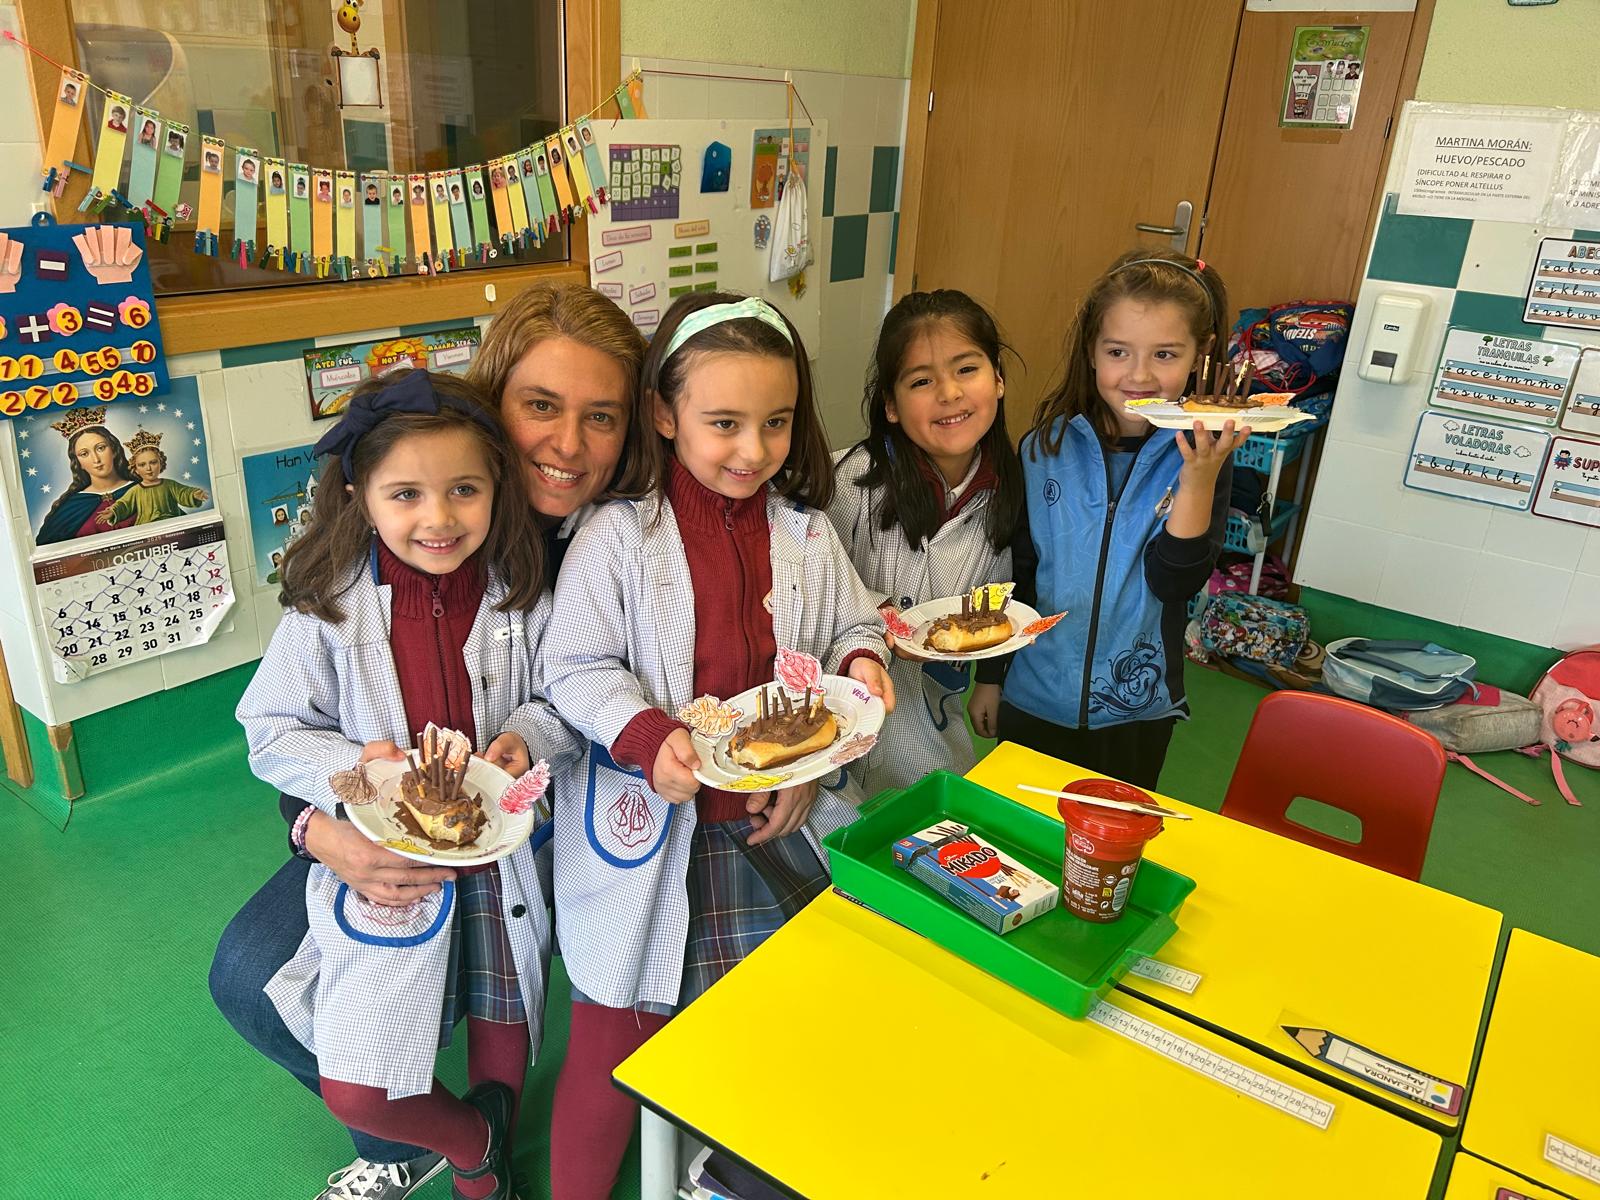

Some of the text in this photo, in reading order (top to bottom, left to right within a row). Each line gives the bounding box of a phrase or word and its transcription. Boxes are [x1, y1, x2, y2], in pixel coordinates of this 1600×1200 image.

[1436, 137, 1533, 150] MARTINA MORÁN:
[1435, 154, 1525, 167] HUEVO/PESCADO
[1415, 179, 1503, 191] SÍNCOPE PONER ALTELLUS
[1417, 169, 1459, 178] (DIFICULTAD
[1471, 172, 1503, 180] RESPIRAR
[1562, 283, 1569, 295] k
[1582, 290, 1597, 298] m
[62, 307, 146, 331] 3 6
[1477, 346, 1540, 365] TRANQUILAS
[1493, 337, 1532, 352] LETRAS
[1, 343, 154, 378] 1 1 4 5 5 10
[1457, 367, 1467, 375] a
[1470, 369, 1479, 377] c
[1495, 371, 1502, 380] i
[1505, 375, 1521, 384] m
[1523, 377, 1536, 386] n
[5, 373, 149, 413] 2 7 2 9 4 8
[1473, 391, 1483, 400] u
[1524, 400, 1536, 408] x
[1545, 403, 1555, 411] z
[1460, 424, 1504, 440] LETRAS
[1445, 433, 1512, 455] VOLADORAS
[276, 453, 302, 470] Han
[1445, 460, 1456, 472] d
[1463, 463, 1474, 476] h
[1481, 466, 1489, 479] k
[1512, 472, 1521, 485] t
[1573, 456, 1600, 472] SUP
[112, 542, 179, 567] OCTUBRE
[109, 551, 216, 585] 1 2 3 4 5
[58, 568, 220, 618] 6 7 8 9 10 11 12
[59, 584, 223, 638] 13 14 15 16 17 18 19
[62, 608, 203, 657] 20 21 22 23 24 25
[91, 632, 181, 666] 28 29 30 31
[941, 846, 998, 876] MIKADO
[1098, 1009, 1106, 1017] 11
[1119, 1019, 1128, 1027] 13
[1130, 1024, 1138, 1032] 14
[1140, 1029, 1149, 1037] 15
[1151, 1034, 1160, 1042] 16
[1162, 1039, 1172, 1047] 17
[1173, 1044, 1182, 1052] 18
[1184, 1050, 1193, 1058] 19
[1195, 1055, 1205, 1063] 20
[1206, 1060, 1216, 1068] 21
[1218, 1065, 1228, 1074] 22
[1229, 1071, 1240, 1079] 23
[1241, 1076, 1251, 1084] 24
[1253, 1081, 1264, 1090] 25
[1265, 1087, 1276, 1095] 26
[1277, 1092, 1288, 1101] 27
[1289, 1098, 1301, 1106] 28
[1302, 1103, 1314, 1112] 29
[1315, 1108, 1326, 1117] 30
[1363, 1066, 1422, 1094] ALEJANDRA
